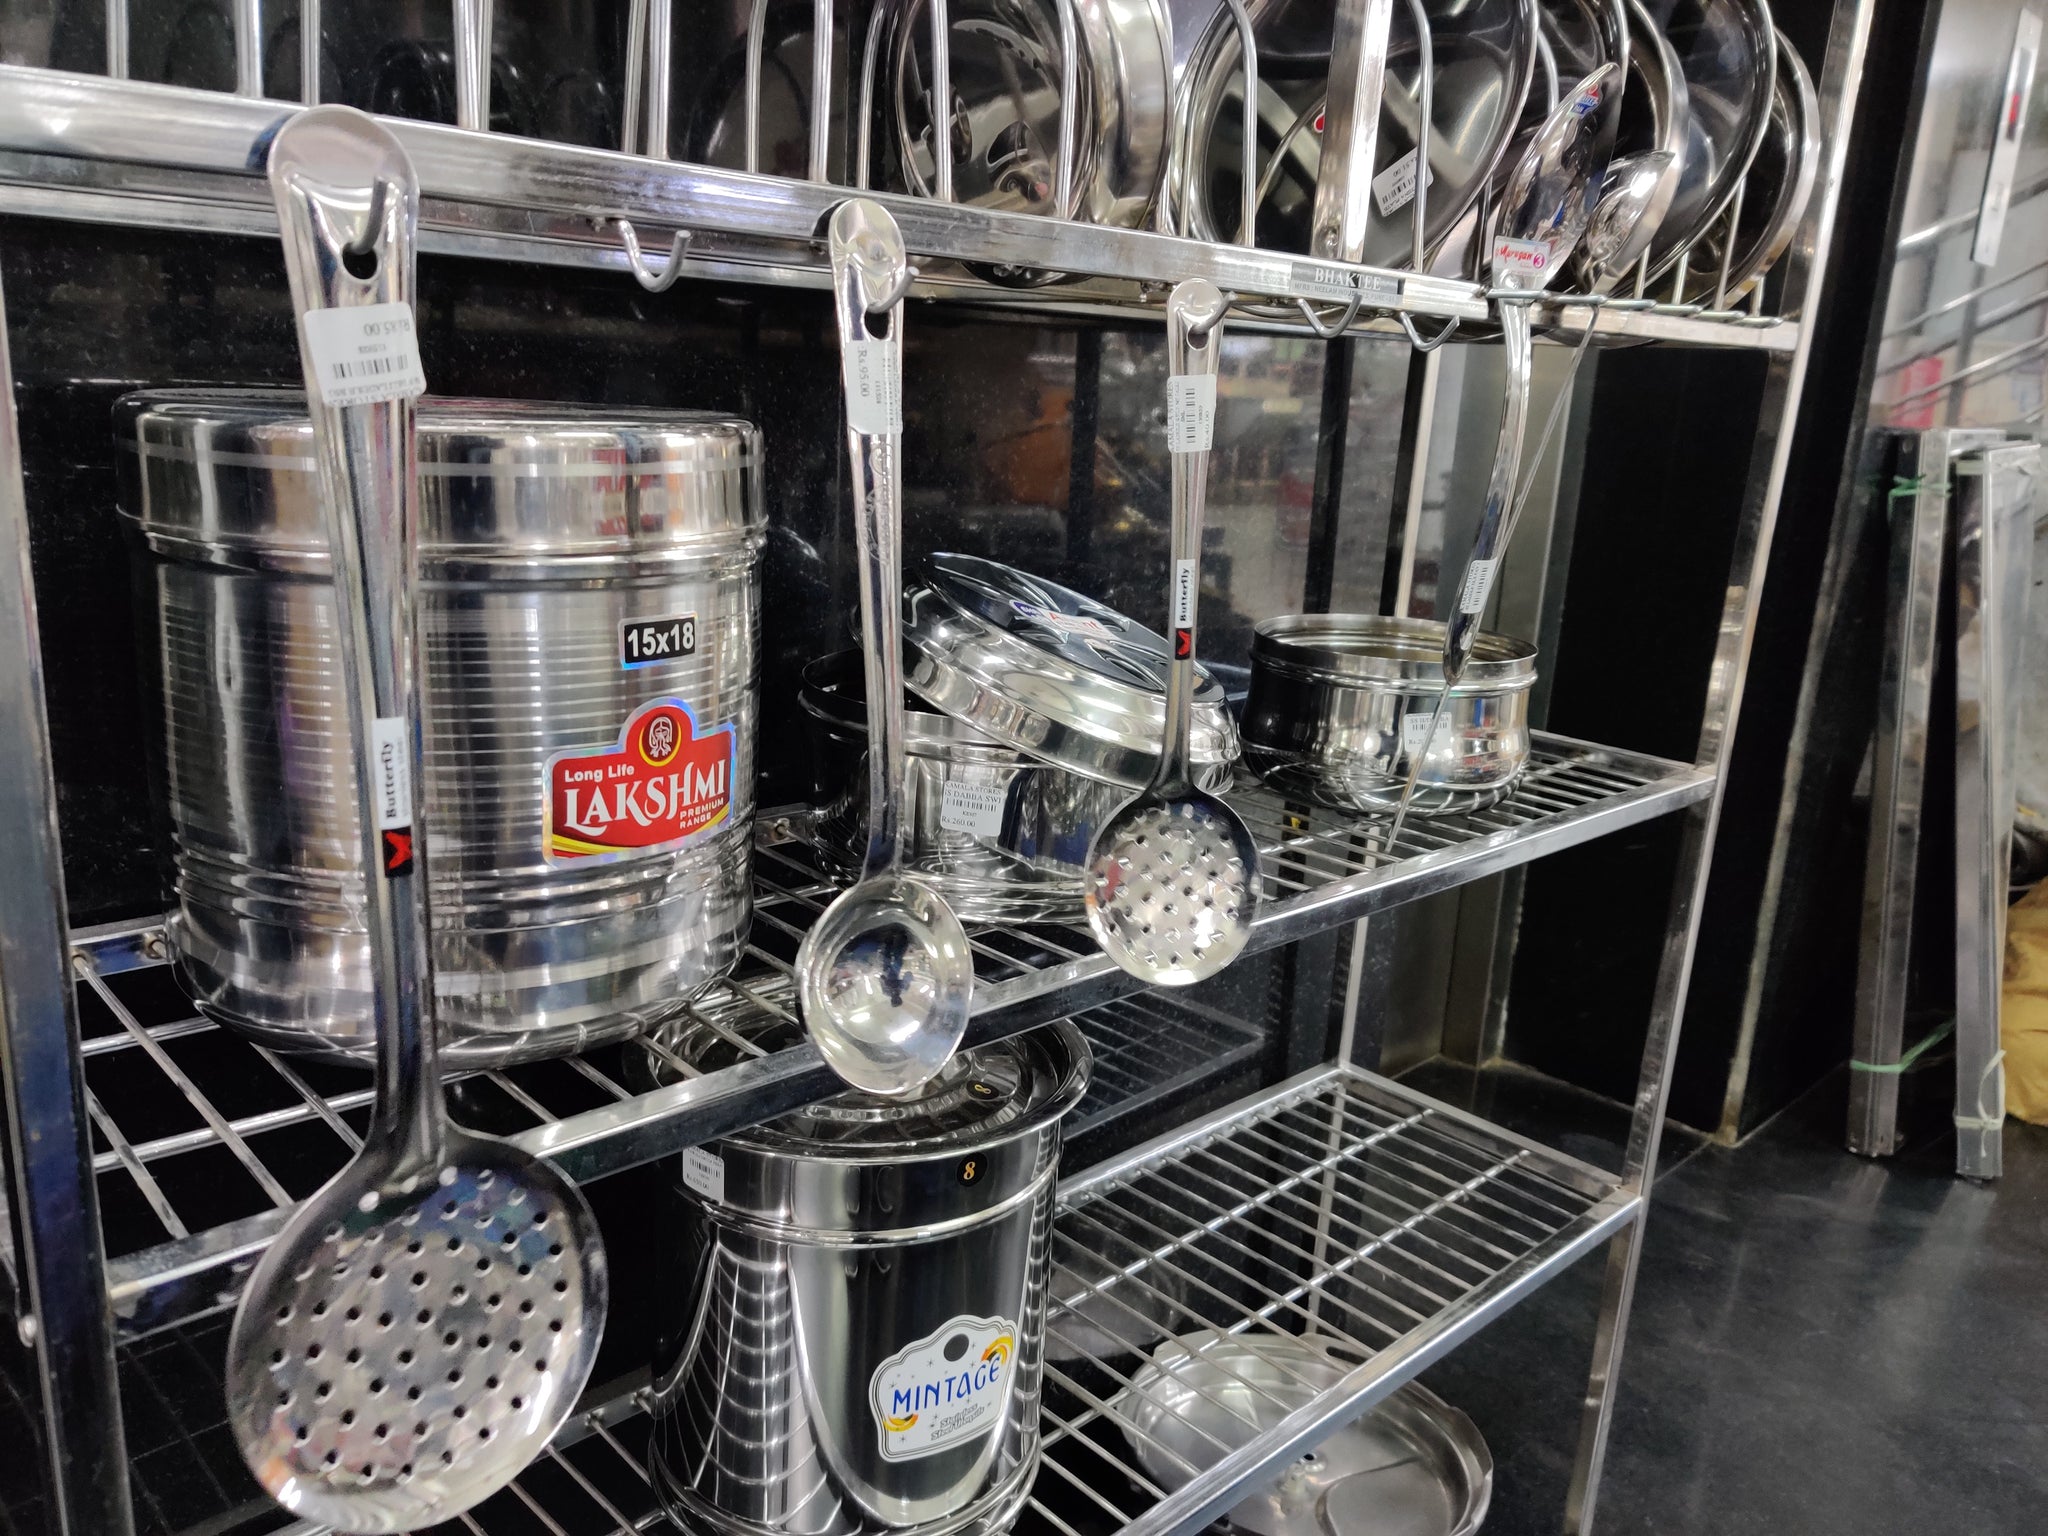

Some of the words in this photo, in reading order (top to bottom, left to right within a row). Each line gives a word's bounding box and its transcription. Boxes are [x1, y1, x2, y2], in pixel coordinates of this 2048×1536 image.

[1314, 267, 1382, 291] BHAKTEE
[1179, 568, 1190, 622] Butterfly
[627, 622, 694, 658] 15x18
[381, 741, 397, 819] Butterfly
[564, 768, 604, 783] Long
[608, 763, 635, 778] Life
[563, 759, 726, 837] LAKSHMI
[953, 790, 983, 802] DABBA
[679, 797, 724, 820] PREMIUM
[679, 812, 712, 830] RANGE
[974, 1084, 992, 1094] 8
[963, 1160, 976, 1181] 8
[892, 1356, 1001, 1415] MINTAGE
